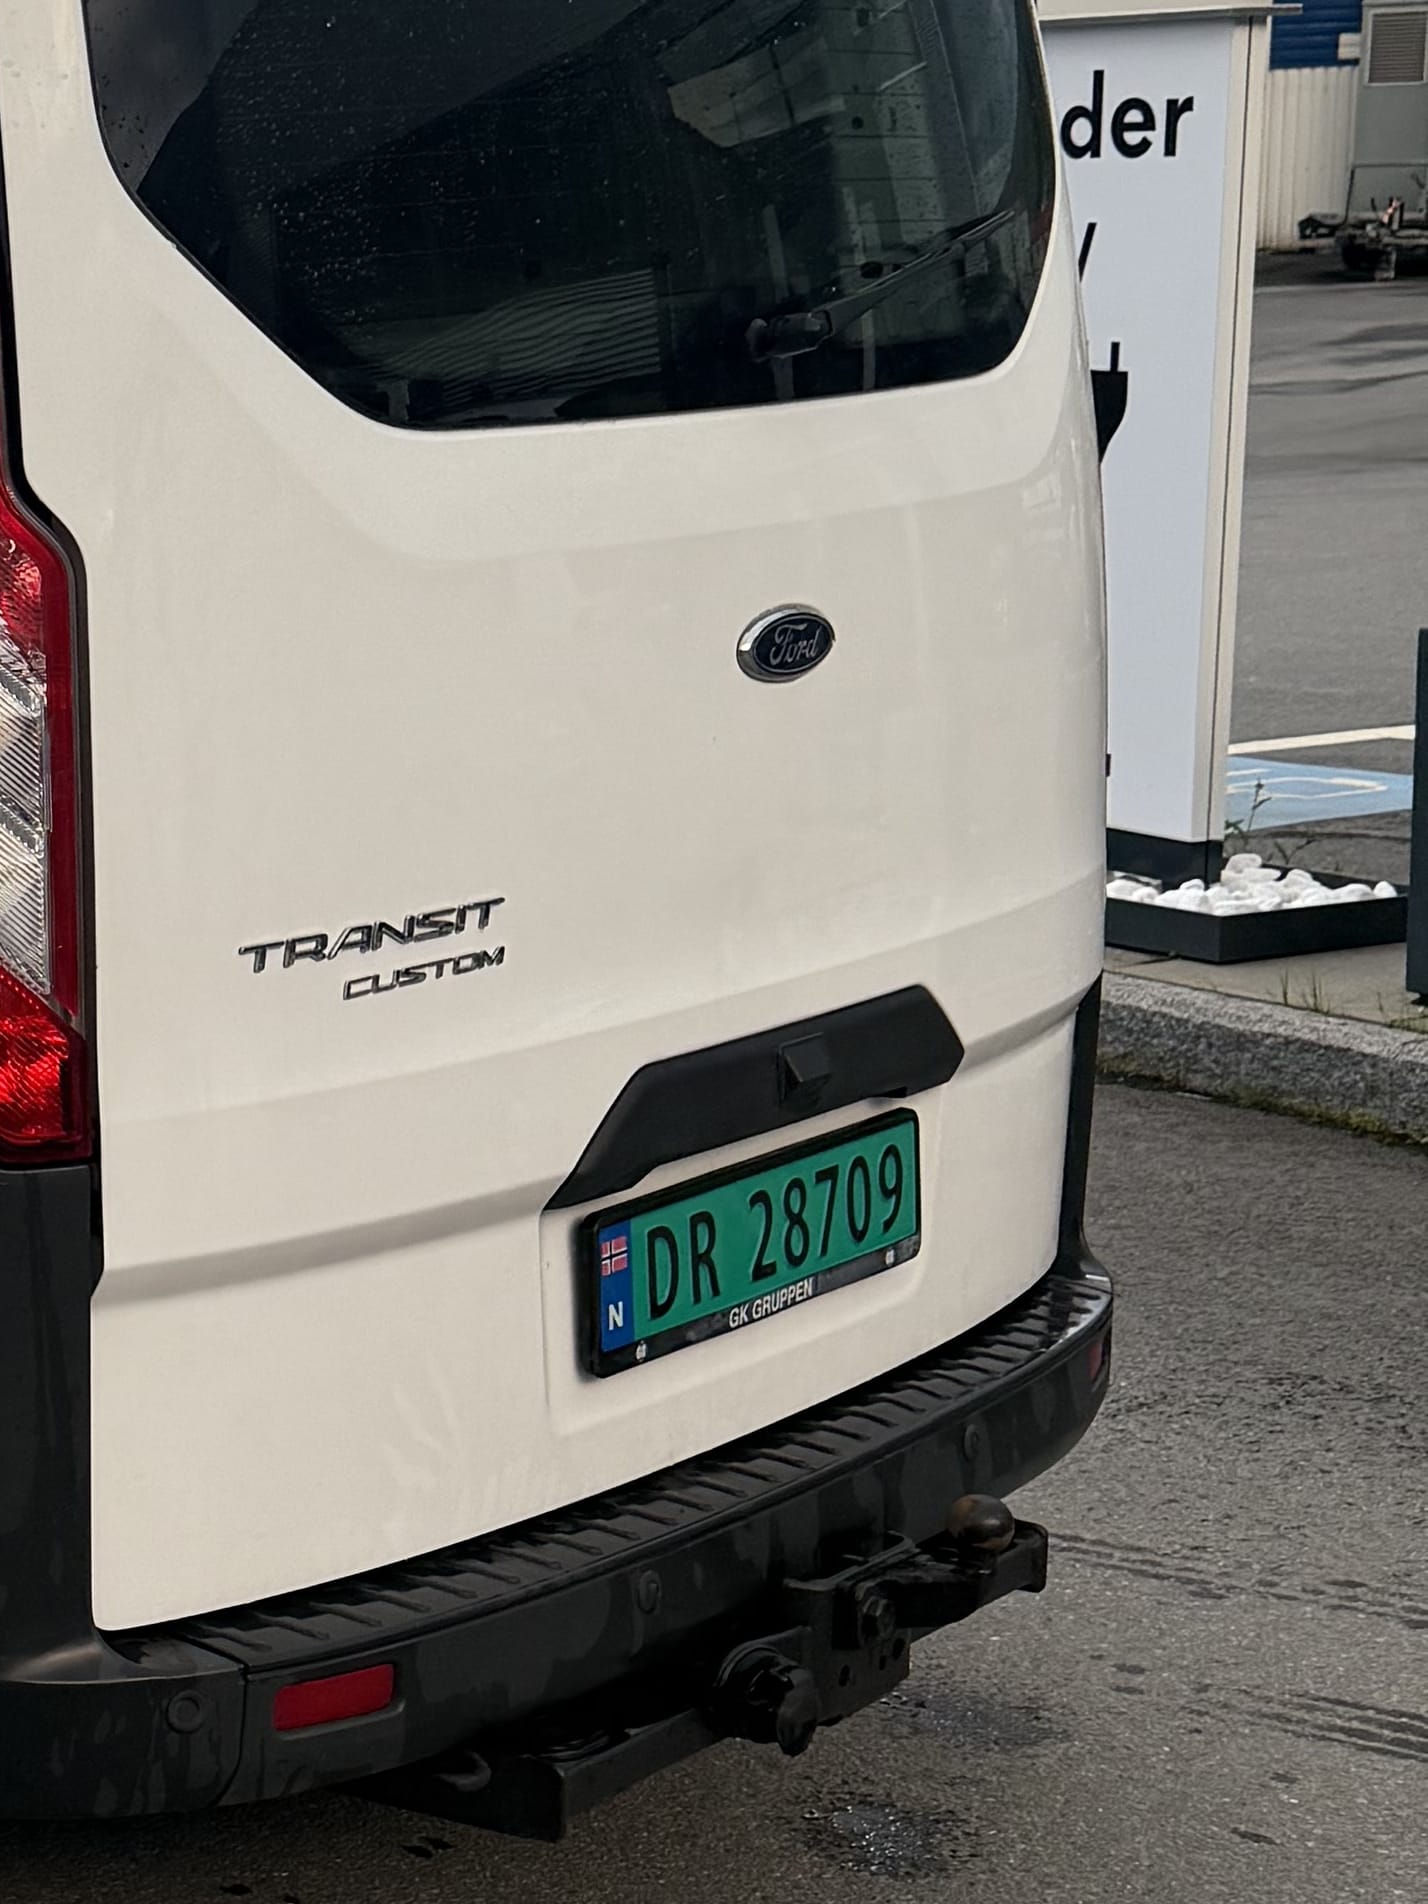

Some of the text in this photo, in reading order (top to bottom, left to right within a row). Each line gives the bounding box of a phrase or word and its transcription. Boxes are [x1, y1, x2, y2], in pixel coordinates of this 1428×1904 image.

[769, 623, 822, 666] Ford
[238, 897, 505, 973] TRANSIT
[343, 945, 505, 1000] CUSTOM
[646, 1143, 903, 1321] DR 28709
[607, 1301, 625, 1331] N
[729, 1277, 814, 1328] GK GRUPPEN
